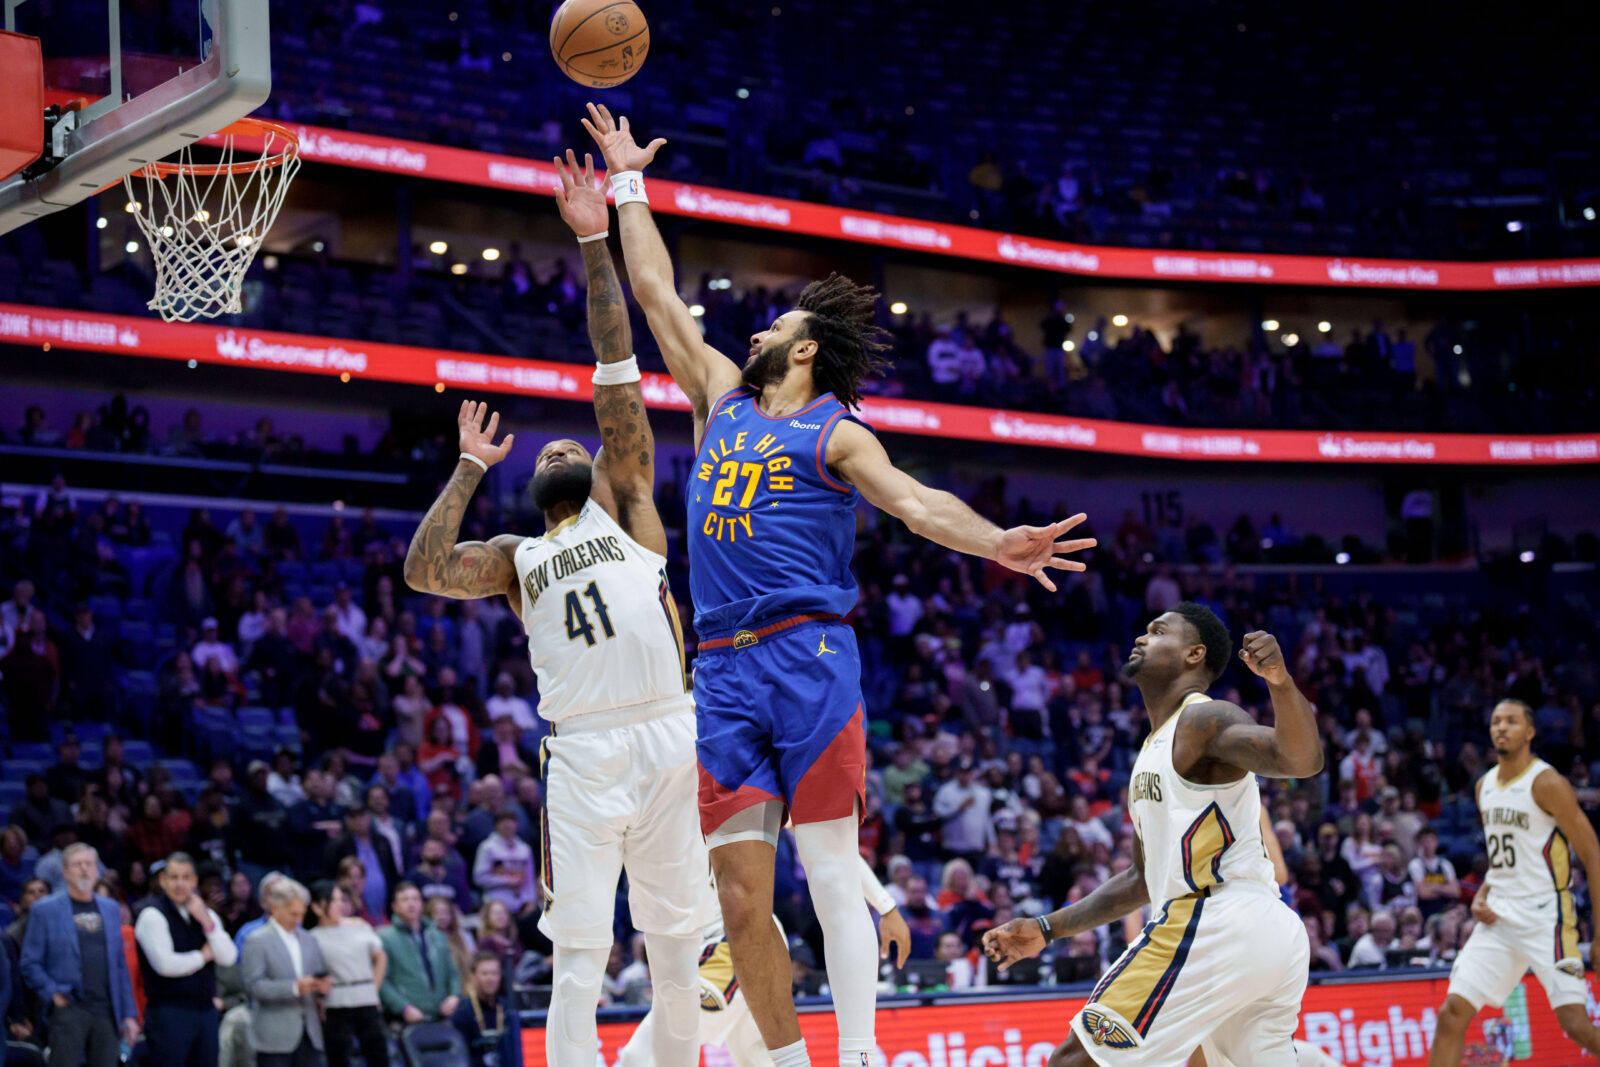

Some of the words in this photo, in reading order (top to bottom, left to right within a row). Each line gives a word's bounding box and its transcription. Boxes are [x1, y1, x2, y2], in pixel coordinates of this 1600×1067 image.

[789, 419, 821, 430] ibotta
[697, 431, 749, 482] MILE
[753, 433, 794, 490] HIGH
[711, 460, 764, 509] 27
[703, 511, 754, 543] CITY
[523, 559, 549, 609] NEW
[552, 535, 626, 580] ORLEANS
[564, 580, 616, 648] 41
[1488, 833, 1516, 869] 25
[876, 1028, 1058, 1067] elicio
